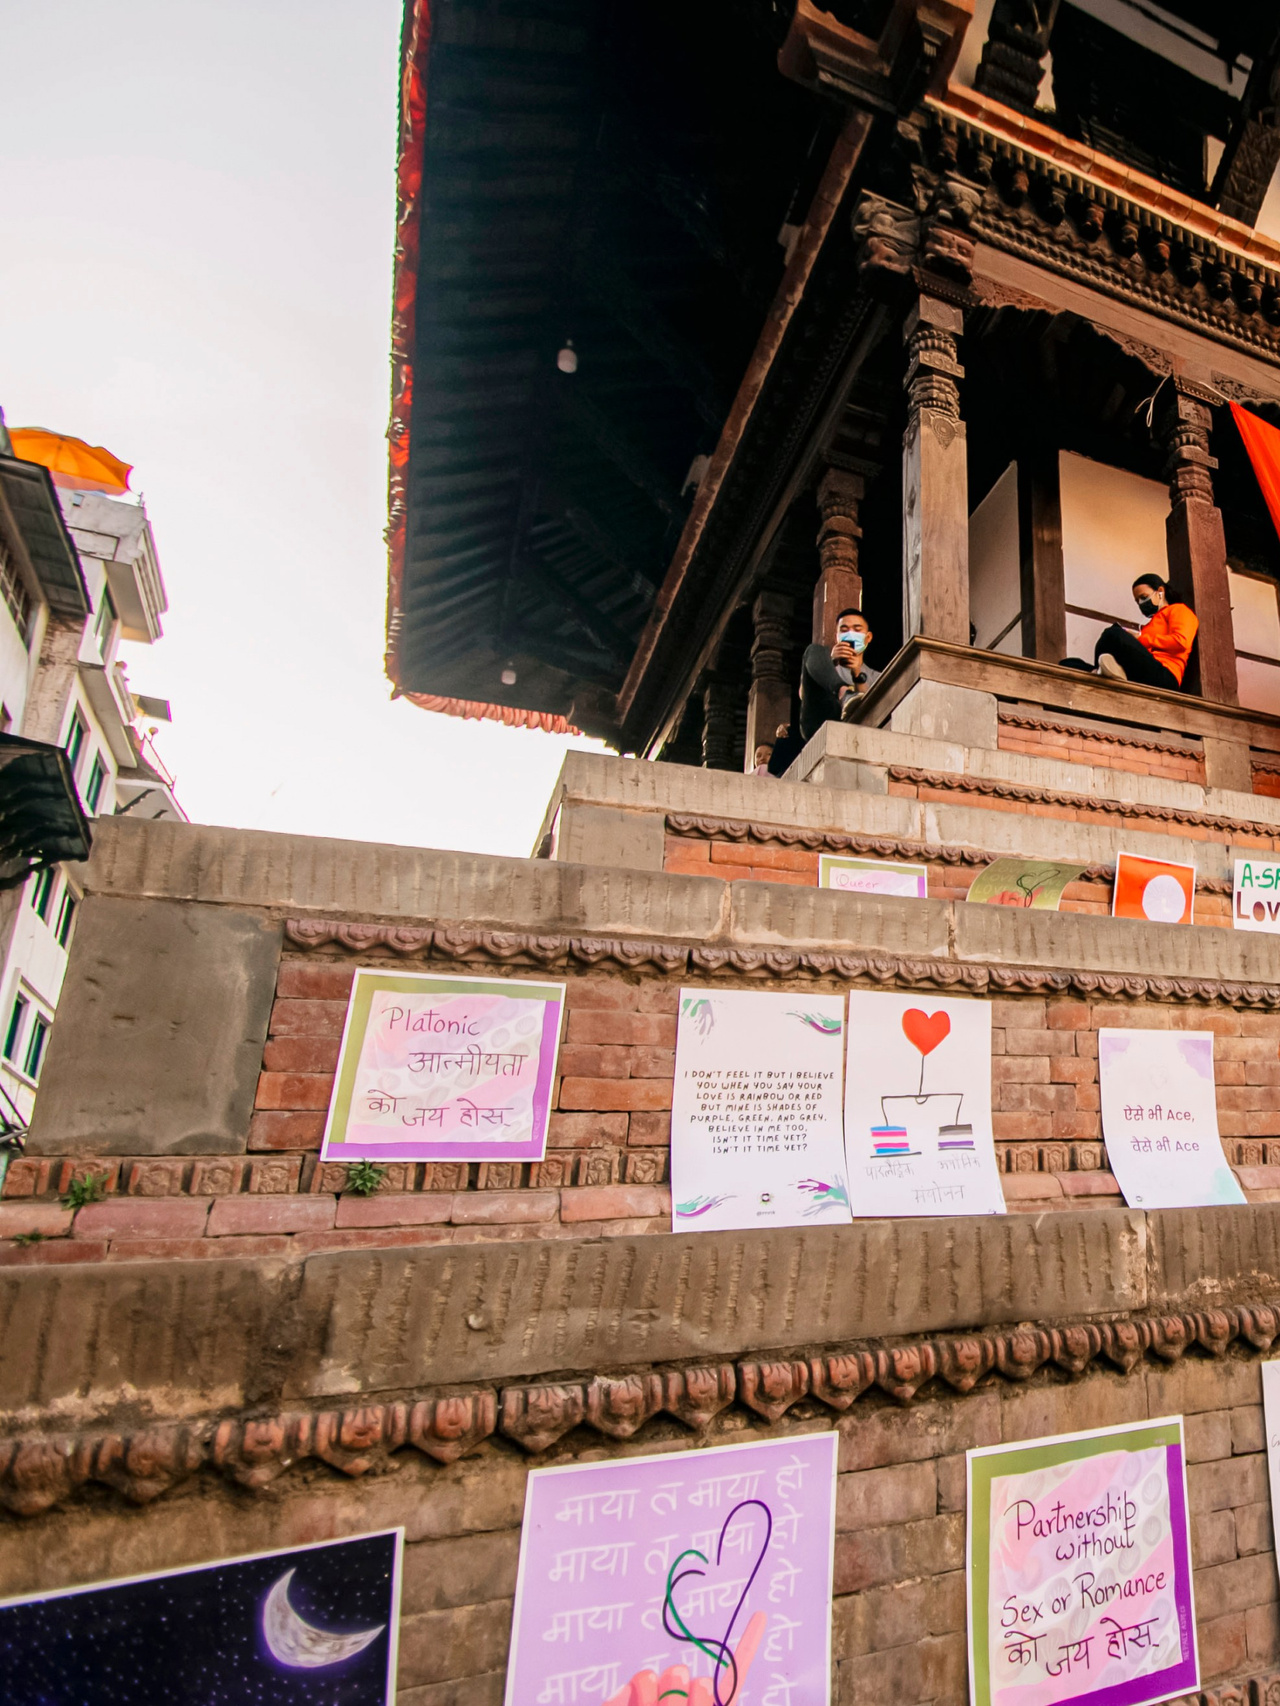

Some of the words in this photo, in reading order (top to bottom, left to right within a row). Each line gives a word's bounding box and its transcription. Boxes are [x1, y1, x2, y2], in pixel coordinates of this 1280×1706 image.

[836, 874, 880, 888] Queer
[382, 1007, 480, 1036] Platonic
[407, 1044, 528, 1077] आत्मीयता
[367, 1089, 407, 1114] को
[402, 1108, 450, 1127] जय
[1124, 1105, 1144, 1121] ऐसे
[1148, 1104, 1162, 1121] भी
[1167, 1109, 1195, 1123] Ace,
[1156, 1136, 1171, 1152] भी
[1176, 1141, 1199, 1152] Ace
[556, 1489, 640, 1525] माया
[650, 1482, 684, 1516] त
[688, 1470, 766, 1509] माया
[775, 1455, 810, 1499] हो
[1004, 1490, 1136, 1541] Partnership
[548, 1542, 636, 1583] माया
[644, 1534, 678, 1575] त
[690, 1522, 755, 1561] माया
[771, 1503, 804, 1550] हो
[1055, 1524, 1135, 1561] without
[542, 1602, 634, 1643] माया
[678, 1577, 750, 1618] माया
[767, 1558, 802, 1602] हो
[1000, 1594, 1044, 1628] Sex
[1051, 1593, 1070, 1614] or
[1071, 1570, 1167, 1610] Romance
[536, 1661, 622, 1704] माया
[763, 1612, 803, 1662] हो
[1004, 1631, 1047, 1666] को
[1046, 1636, 1095, 1677] जय
